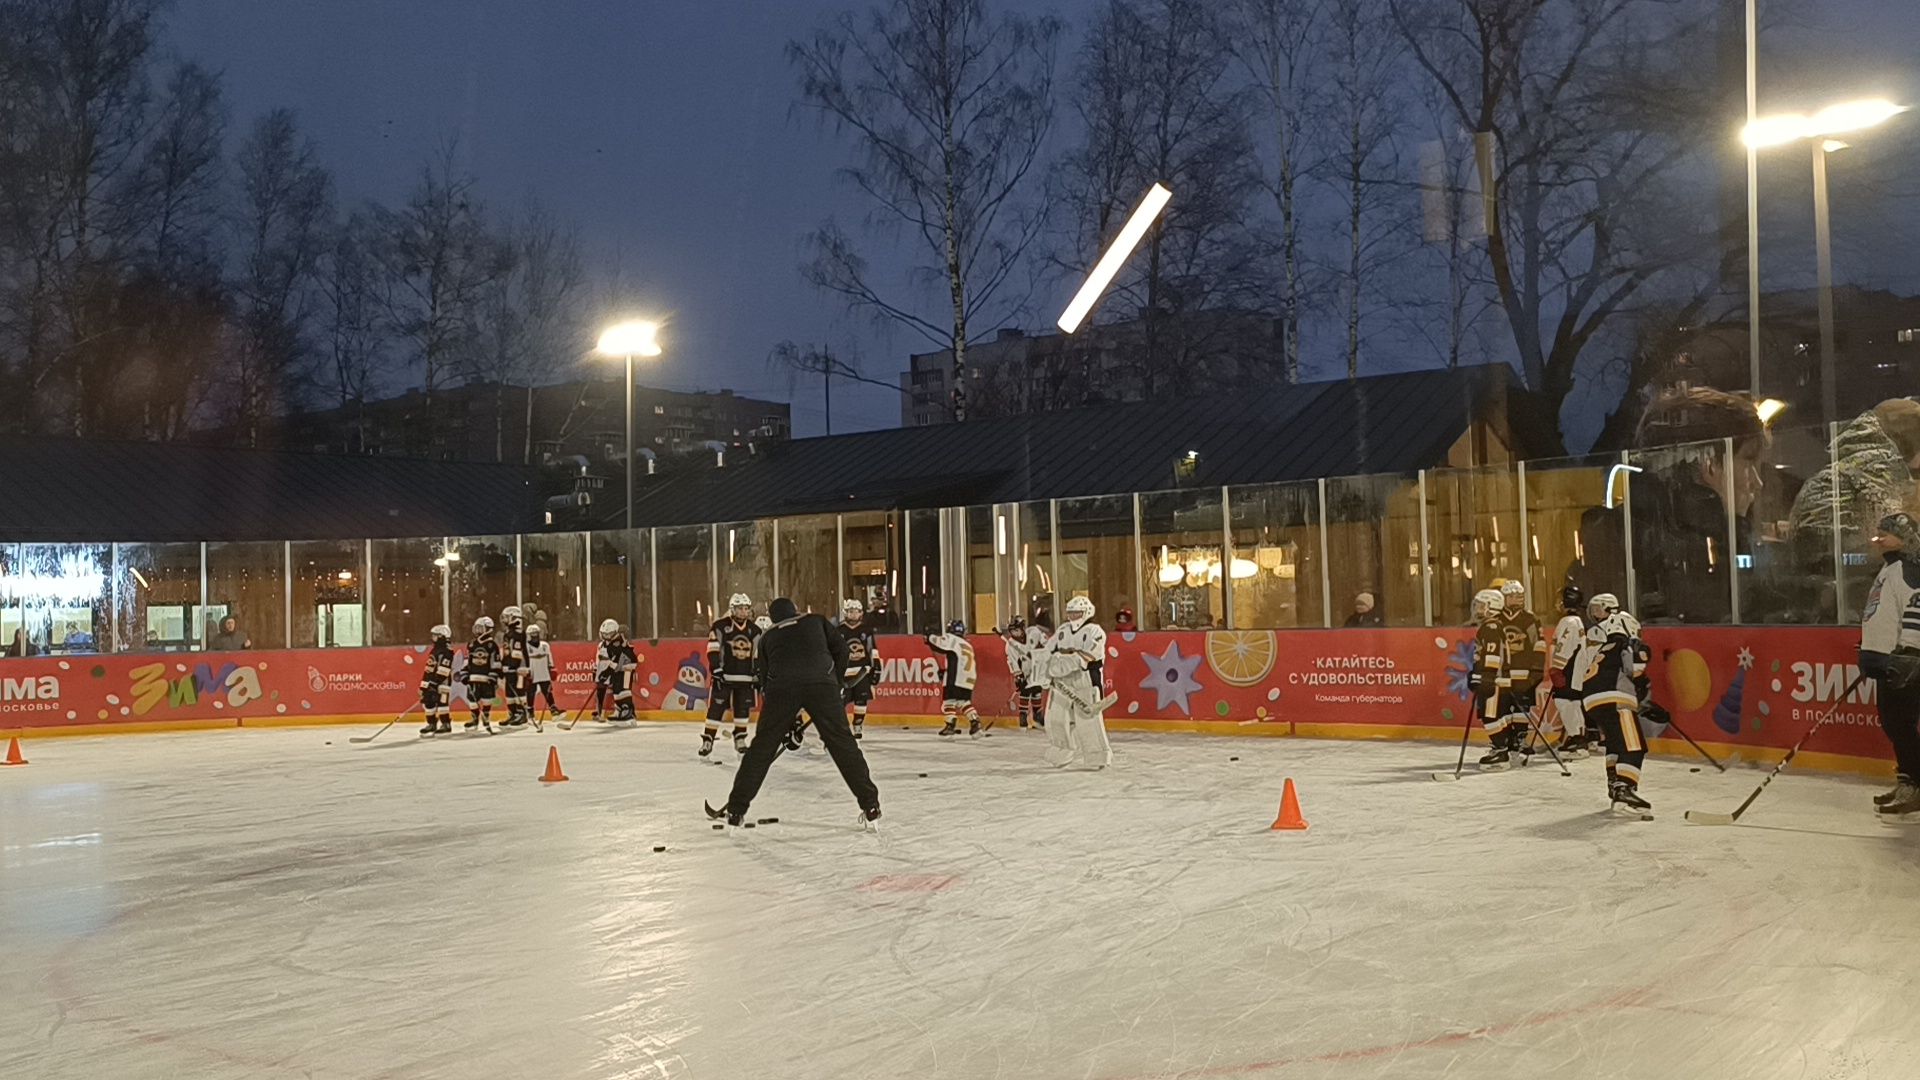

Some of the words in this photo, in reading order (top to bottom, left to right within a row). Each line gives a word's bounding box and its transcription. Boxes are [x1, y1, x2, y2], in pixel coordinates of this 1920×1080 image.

[1486, 642, 1498, 653] 17
[566, 658, 597, 671] КАТАЙ
[1316, 654, 1395, 669] КАТАЙТЕСЬ
[329, 673, 362, 682] ПАРКИ
[1288, 673, 1298, 685] С
[1301, 673, 1426, 686] УДОВОЛЬСТВИЕМ!
[329, 681, 406, 691] ПОДМОСКОВЬЯ
[876, 688, 941, 697] одмосковье
[1315, 693, 1350, 703] Команда
[1351, 695, 1403, 705] губернатора
